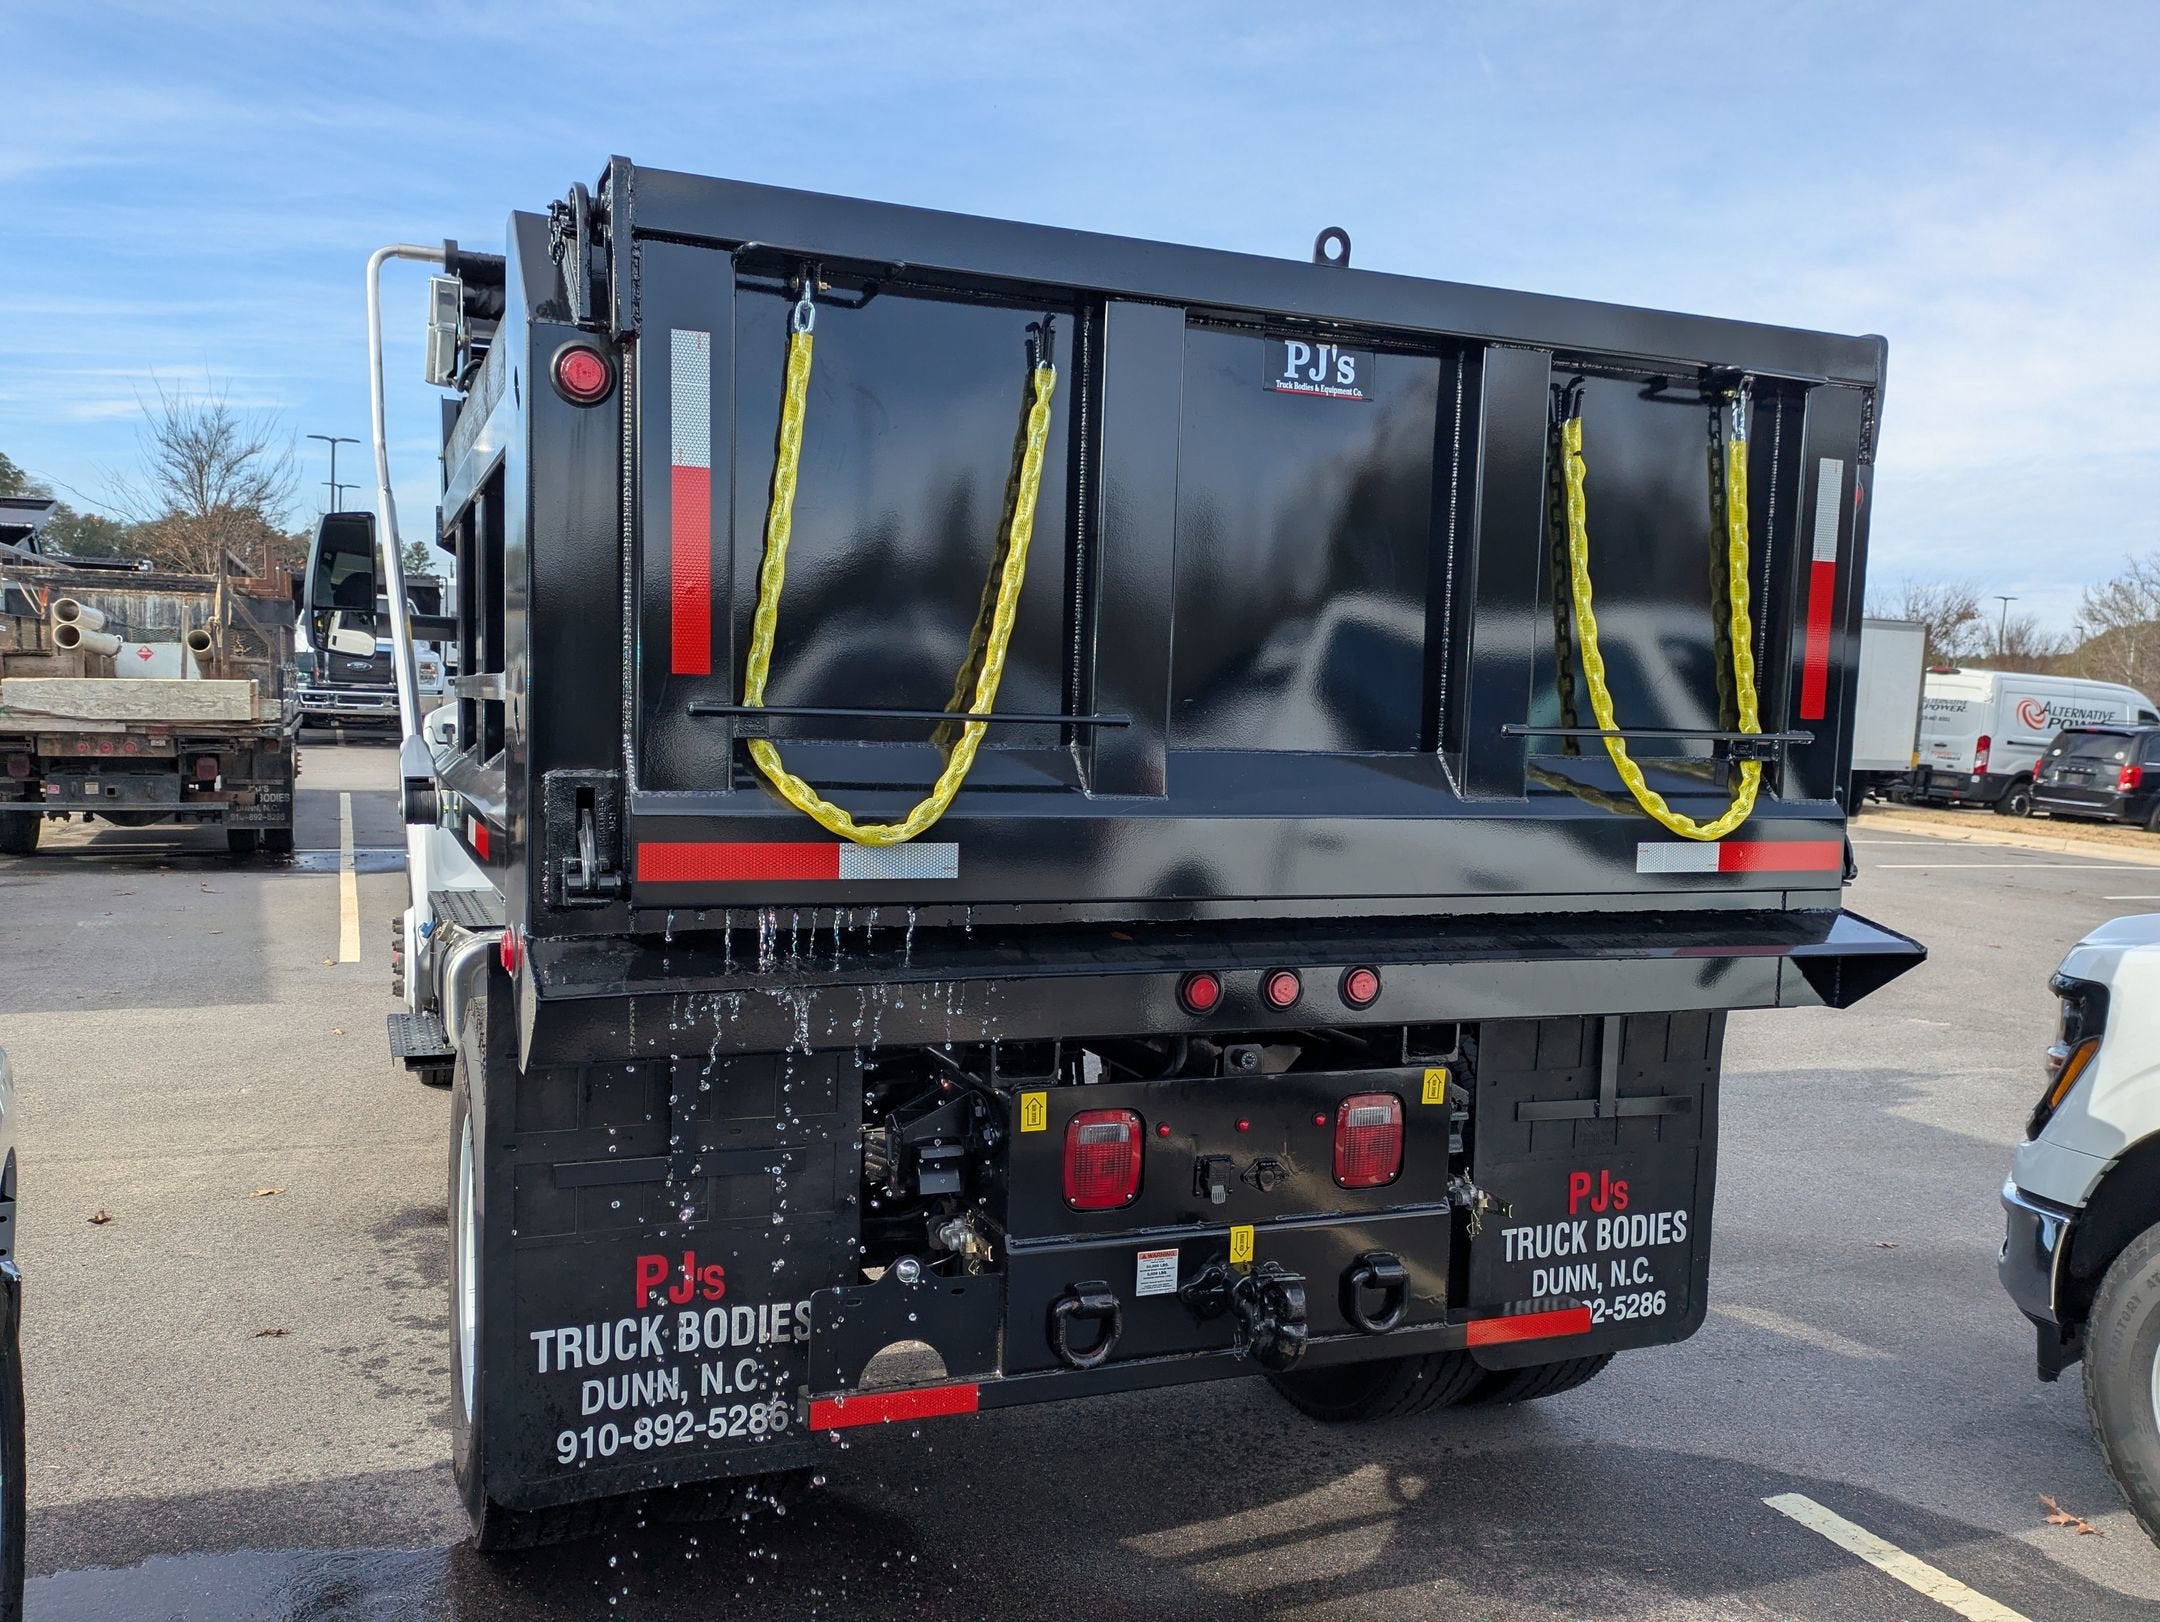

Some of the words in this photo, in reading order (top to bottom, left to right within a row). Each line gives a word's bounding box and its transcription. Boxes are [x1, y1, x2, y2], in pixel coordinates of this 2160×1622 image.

[1284, 340, 1355, 384] PJ's
[1275, 379, 1294, 389] Truck
[1294, 381, 1314, 392] Bodies
[1314, 384, 1321, 392] &
[1321, 384, 1353, 397] Equipment
[1353, 388, 1363, 397] Co.
[1147, 1250, 1175, 1259] WARNING
[1501, 1220, 1588, 1263] TRUCK
[1596, 1209, 1688, 1252] BODIES
[1532, 1263, 1603, 1298] DUNN,
[1610, 1256, 1654, 1288] N.C.
[530, 1314, 664, 1374] TRUCK
[678, 1300, 811, 1353] BODIES
[581, 1367, 688, 1416] DUNN,
[556, 1400, 789, 1465] 910-892-5286
